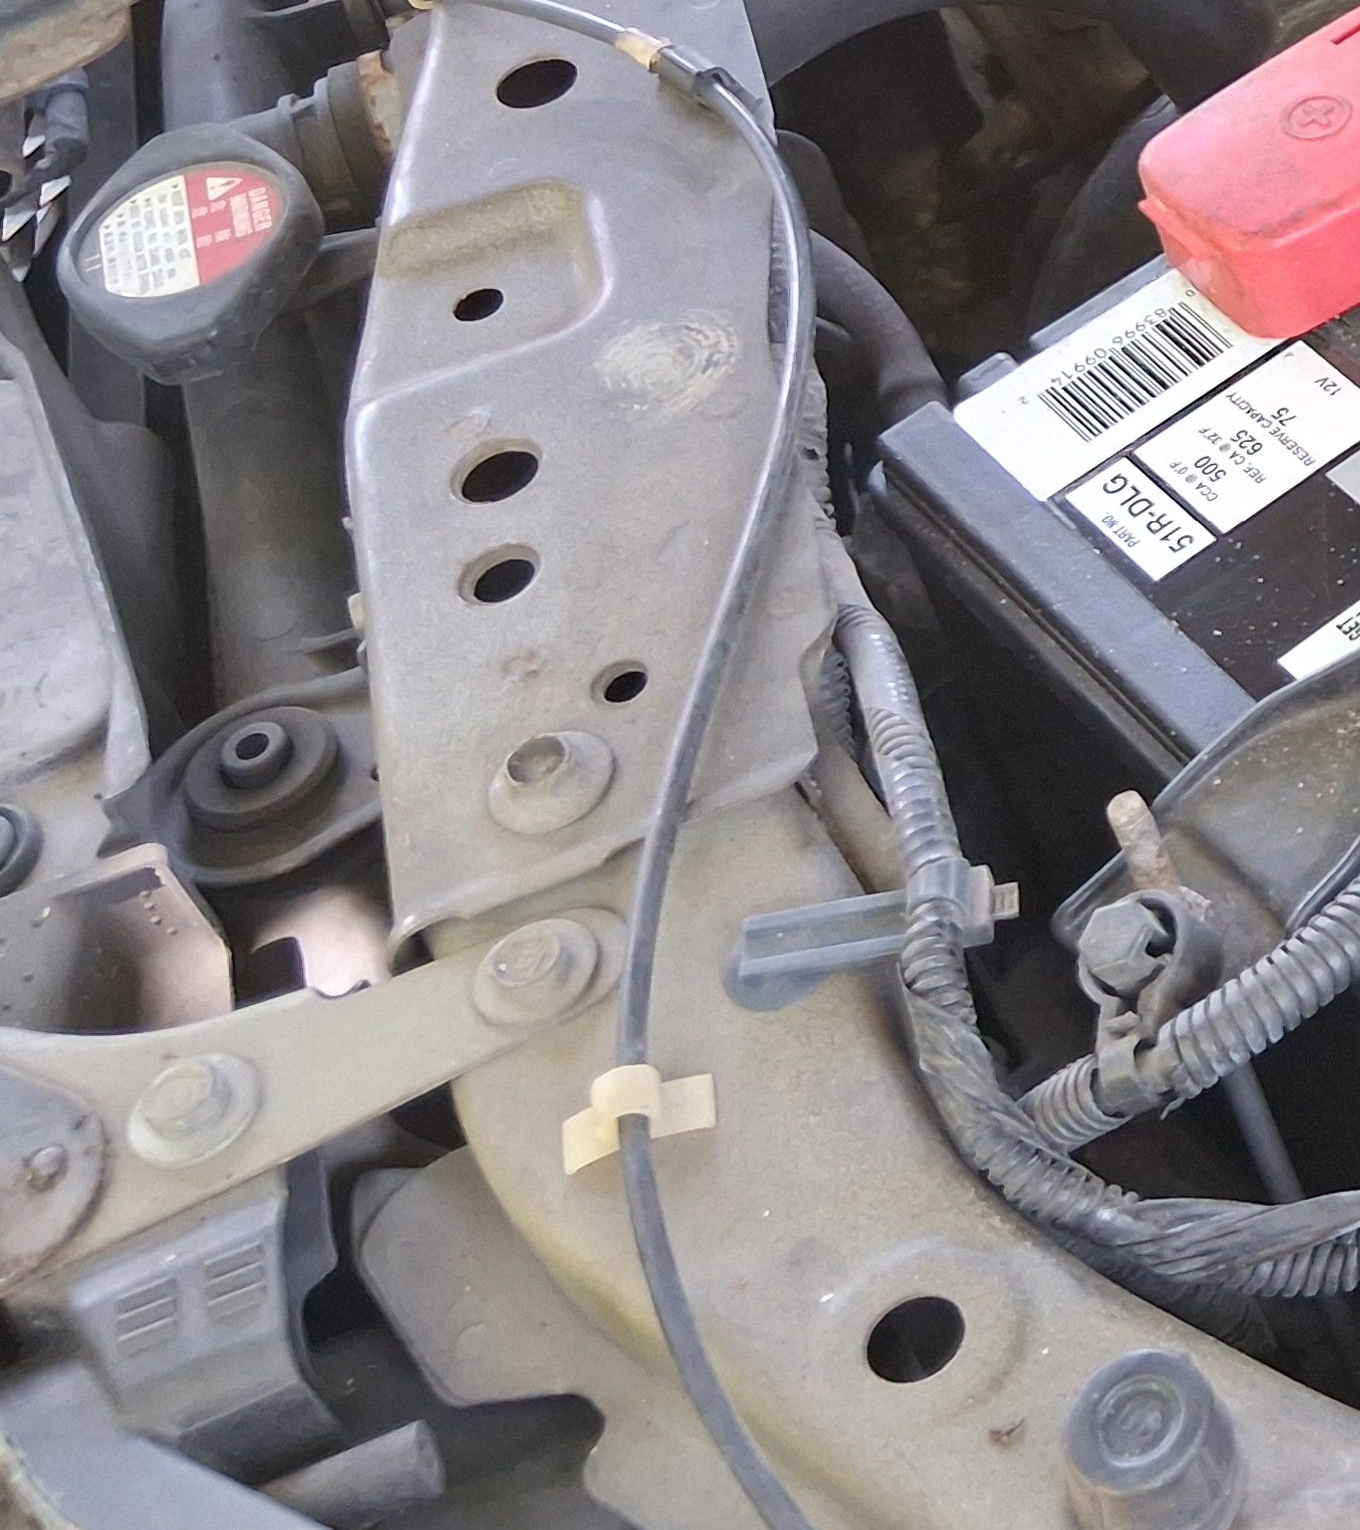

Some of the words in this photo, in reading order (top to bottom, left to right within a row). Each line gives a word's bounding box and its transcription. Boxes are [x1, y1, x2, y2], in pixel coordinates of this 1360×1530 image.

[248, 187, 272, 232] DANGER
[1109, 305, 1170, 347] 83996
[1048, 345, 1109, 387] 09914
[1312, 373, 1343, 397] 12V
[1015, 394, 1031, 406] 2
[1224, 389, 1274, 430] CAPACITY
[1268, 404, 1299, 427] 75
[1228, 427, 1266, 456] 625
[1266, 425, 1318, 467] RESERVE
[1190, 453, 1229, 483] 500
[1226, 449, 1248, 466] CA
[1239, 461, 1269, 484] REF.
[1191, 480, 1220, 503] CCA
[1096, 511, 1120, 529] NO.
[1098, 472, 1197, 554] 51R-DLG
[1109, 523, 1142, 548] PART
